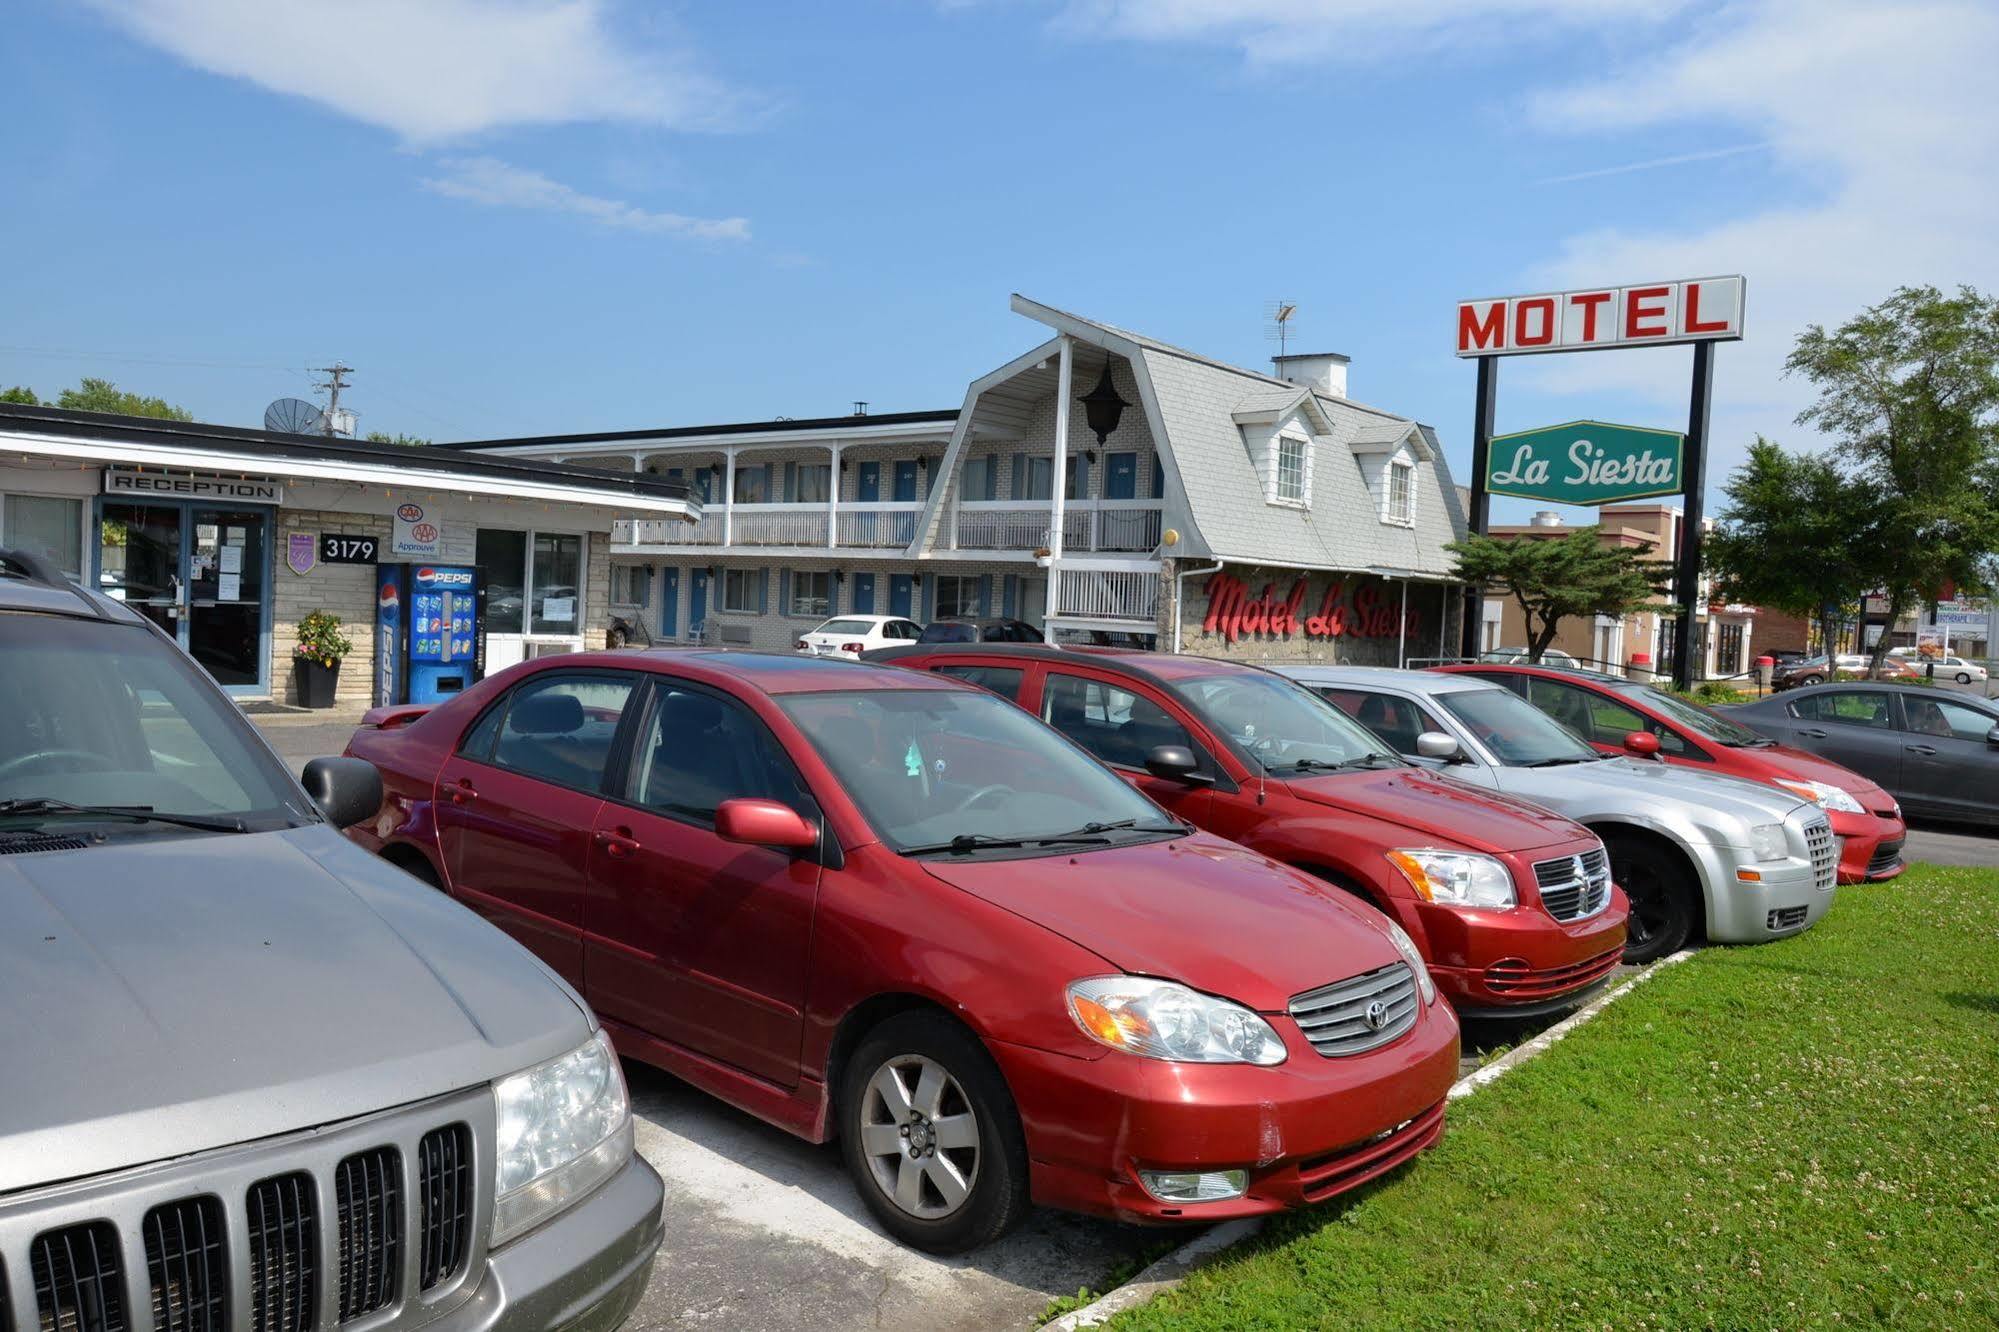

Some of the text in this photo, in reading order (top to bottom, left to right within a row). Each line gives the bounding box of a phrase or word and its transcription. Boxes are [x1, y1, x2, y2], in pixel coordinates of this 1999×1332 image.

[1458, 284, 1729, 351] MOTEL
[1491, 439, 1675, 486] La Siesta
[114, 476, 274, 498] RECEPTION
[414, 525, 437, 541] AAA
[326, 539, 375, 560] 3179
[434, 572, 473, 584] PEPSI
[1202, 573, 1422, 643] Motel La Siesta
